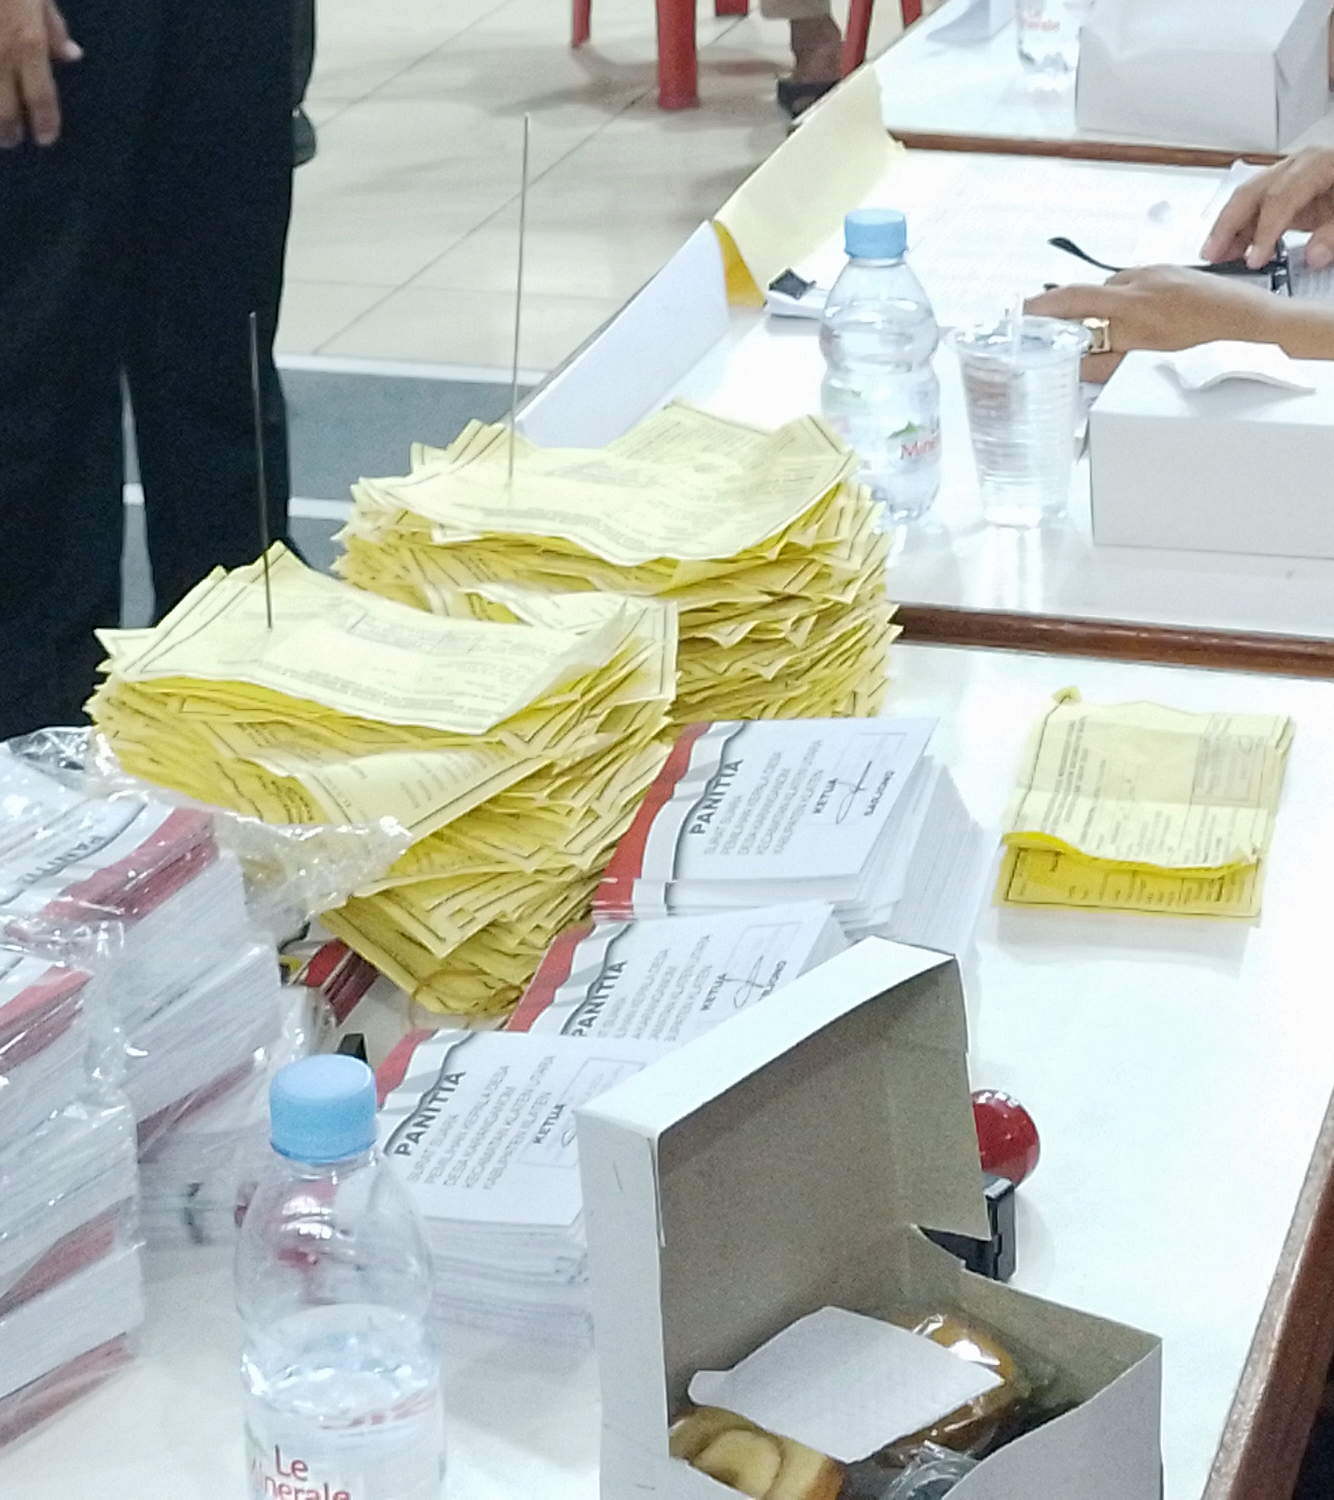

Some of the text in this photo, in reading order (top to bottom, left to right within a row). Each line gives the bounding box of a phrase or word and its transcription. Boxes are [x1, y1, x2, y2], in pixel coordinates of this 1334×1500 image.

[689, 759, 744, 835] PANITIA
[571, 960, 628, 1037] PANITIA
[394, 1071, 466, 1157] PANITIA
[532, 1103, 567, 1145] KETUA
[274, 1443, 309, 1481] Le
